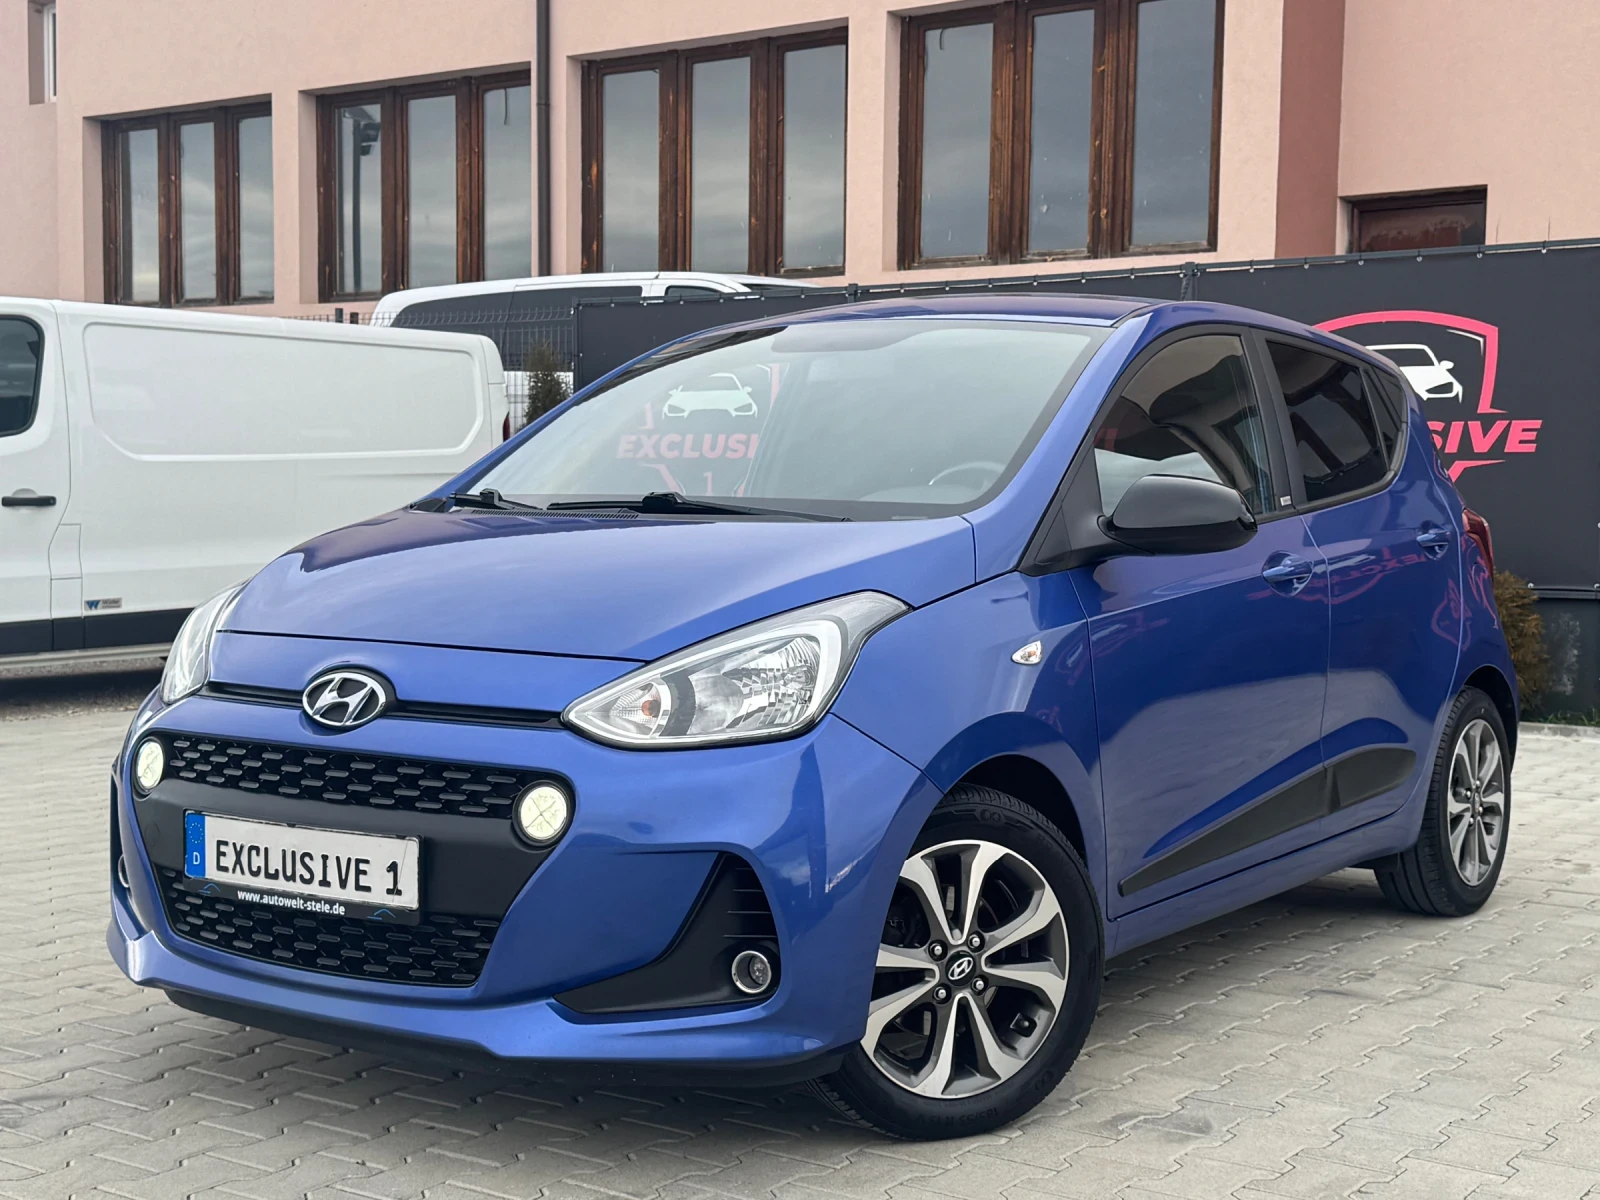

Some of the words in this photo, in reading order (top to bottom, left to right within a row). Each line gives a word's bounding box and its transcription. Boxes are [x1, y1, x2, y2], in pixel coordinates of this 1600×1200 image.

[616, 433, 760, 459] EXCLUSI
[193, 852, 200, 865] D
[216, 839, 372, 893] EXCLUSIVE
[386, 860, 403, 896] 1
[237, 890, 346, 916] www.autowelt-stele.de
